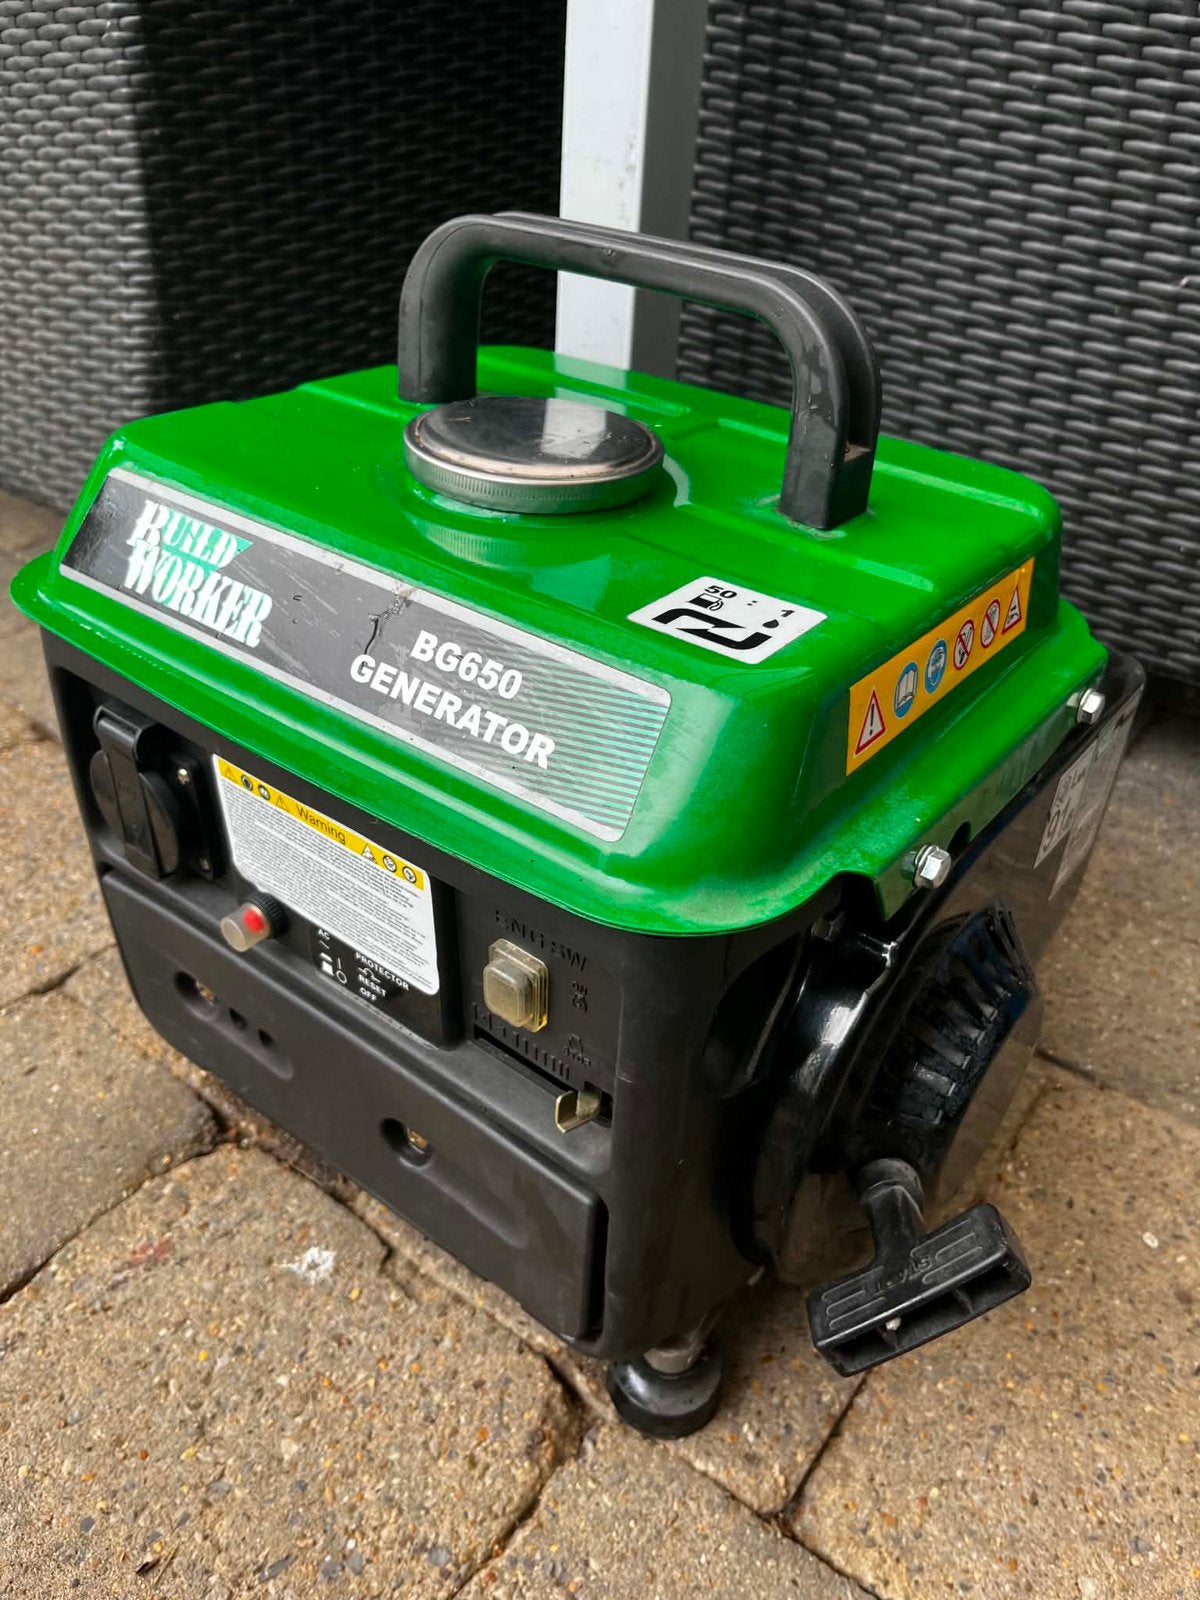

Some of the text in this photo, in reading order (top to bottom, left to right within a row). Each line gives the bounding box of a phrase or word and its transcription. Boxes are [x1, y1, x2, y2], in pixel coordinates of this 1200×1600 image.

[126, 499, 241, 569] BUILD
[124, 538, 273, 648] WORKER
[705, 585, 737, 599] 50
[781, 609, 795, 617] 1
[410, 630, 523, 700] BG650
[350, 653, 556, 770] GENERATOR
[295, 804, 346, 845] Warning
[318, 929, 330, 941] AC
[355, 951, 410, 992] PROTECTOR
[358, 973, 387, 998] RESET
[360, 987, 378, 1001] OFF
